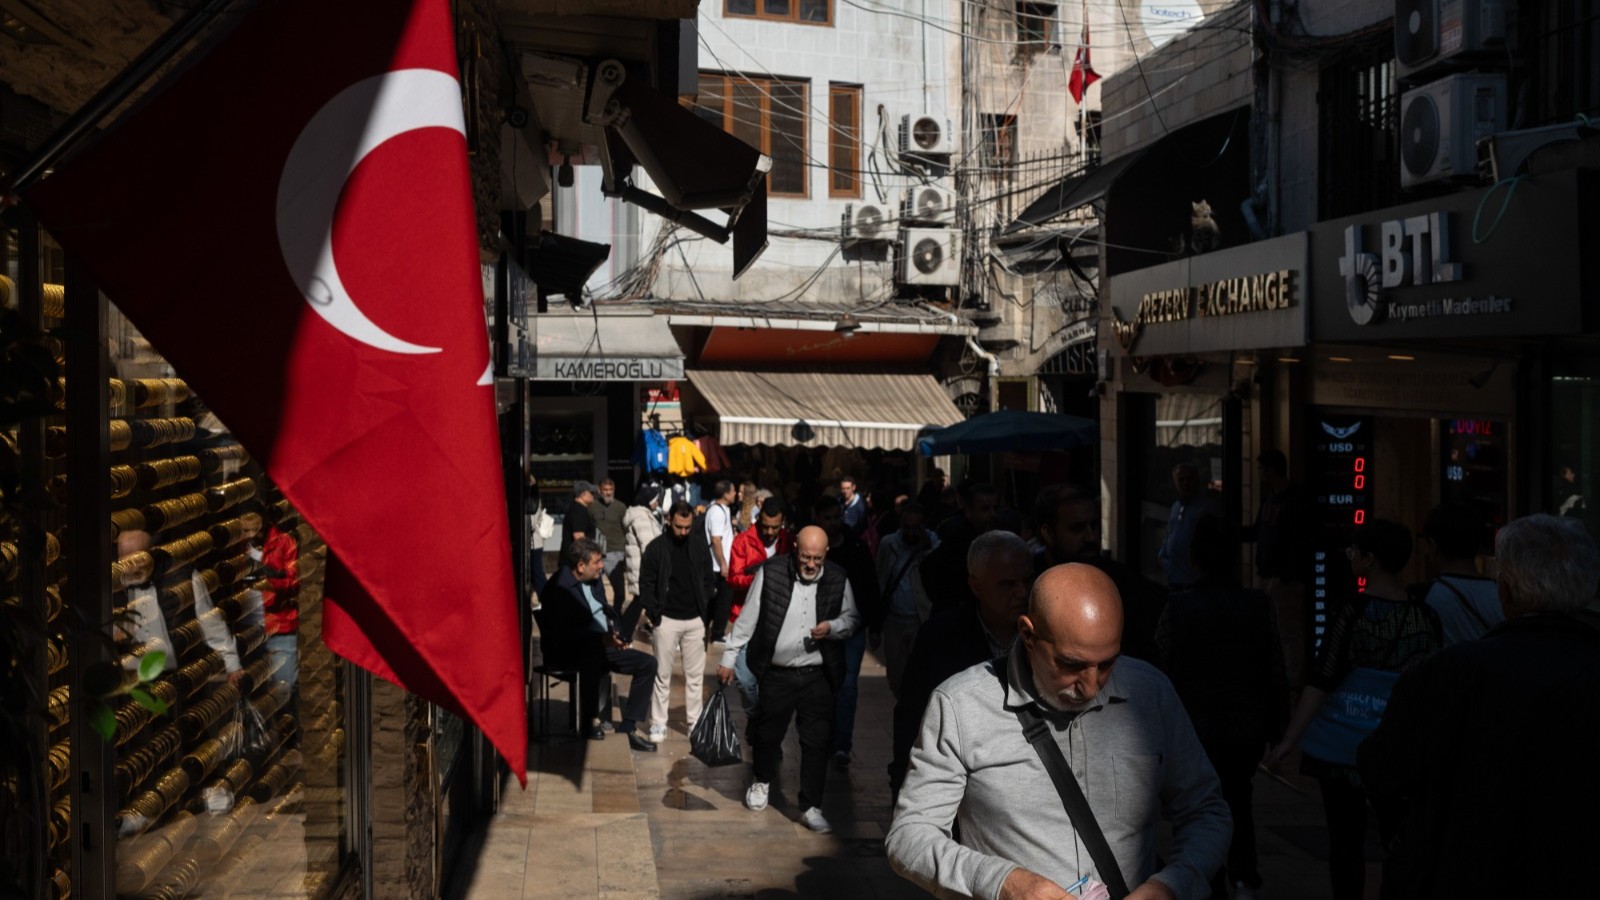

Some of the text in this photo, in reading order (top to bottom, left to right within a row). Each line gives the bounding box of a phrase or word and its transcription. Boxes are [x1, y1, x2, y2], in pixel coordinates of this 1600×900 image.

[1381, 211, 1463, 288] BTL
[1143, 268, 1290, 325] REZERV EXCHANGE
[1442, 296, 1512, 315] Madenler
[554, 357, 663, 379] KAMEROĞLU
[1329, 442, 1354, 453] USD
[1354, 457, 1365, 473] 0
[1446, 465, 1463, 480] USD
[1354, 474, 1365, 490] 0
[1328, 494, 1354, 504] EUR
[1354, 509, 1365, 525] 0
